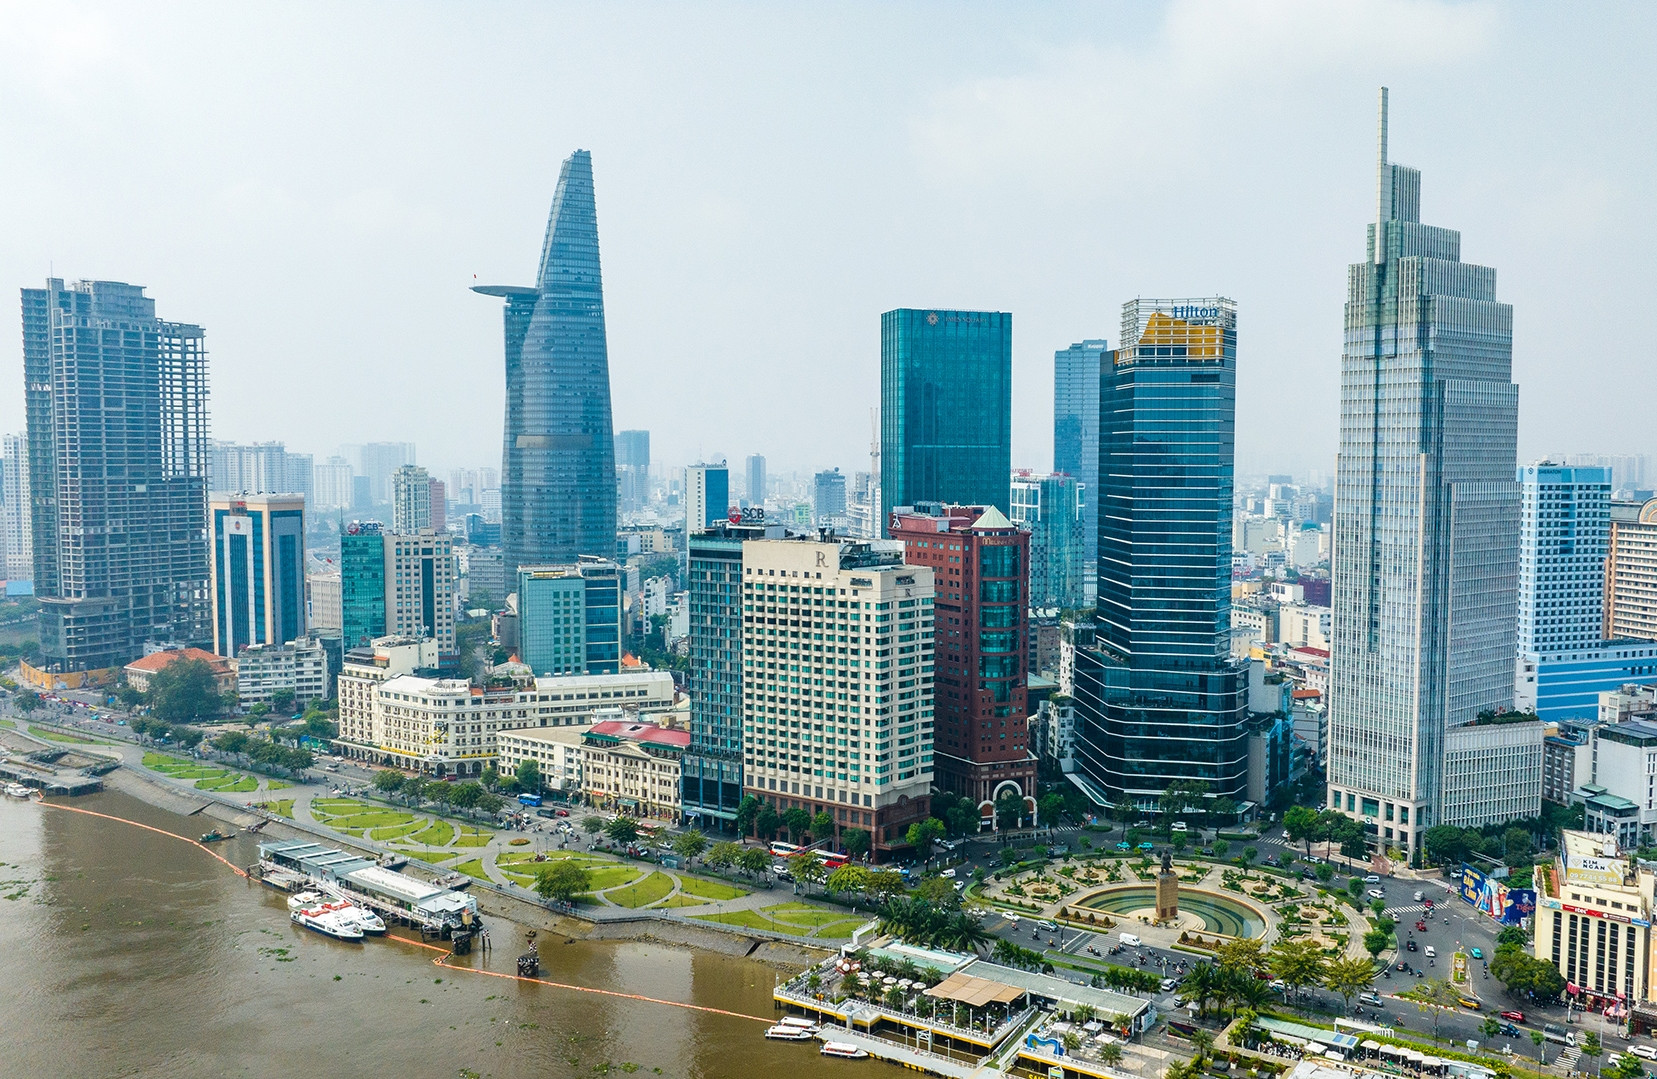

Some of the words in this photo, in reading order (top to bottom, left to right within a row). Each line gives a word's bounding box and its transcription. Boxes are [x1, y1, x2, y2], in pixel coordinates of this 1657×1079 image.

[1173, 305, 1218, 318] Hilton
[742, 507, 764, 519] SCB
[360, 522, 379, 531] SCB
[815, 551, 829, 568] R
[1515, 904, 1535, 913] Tiger
